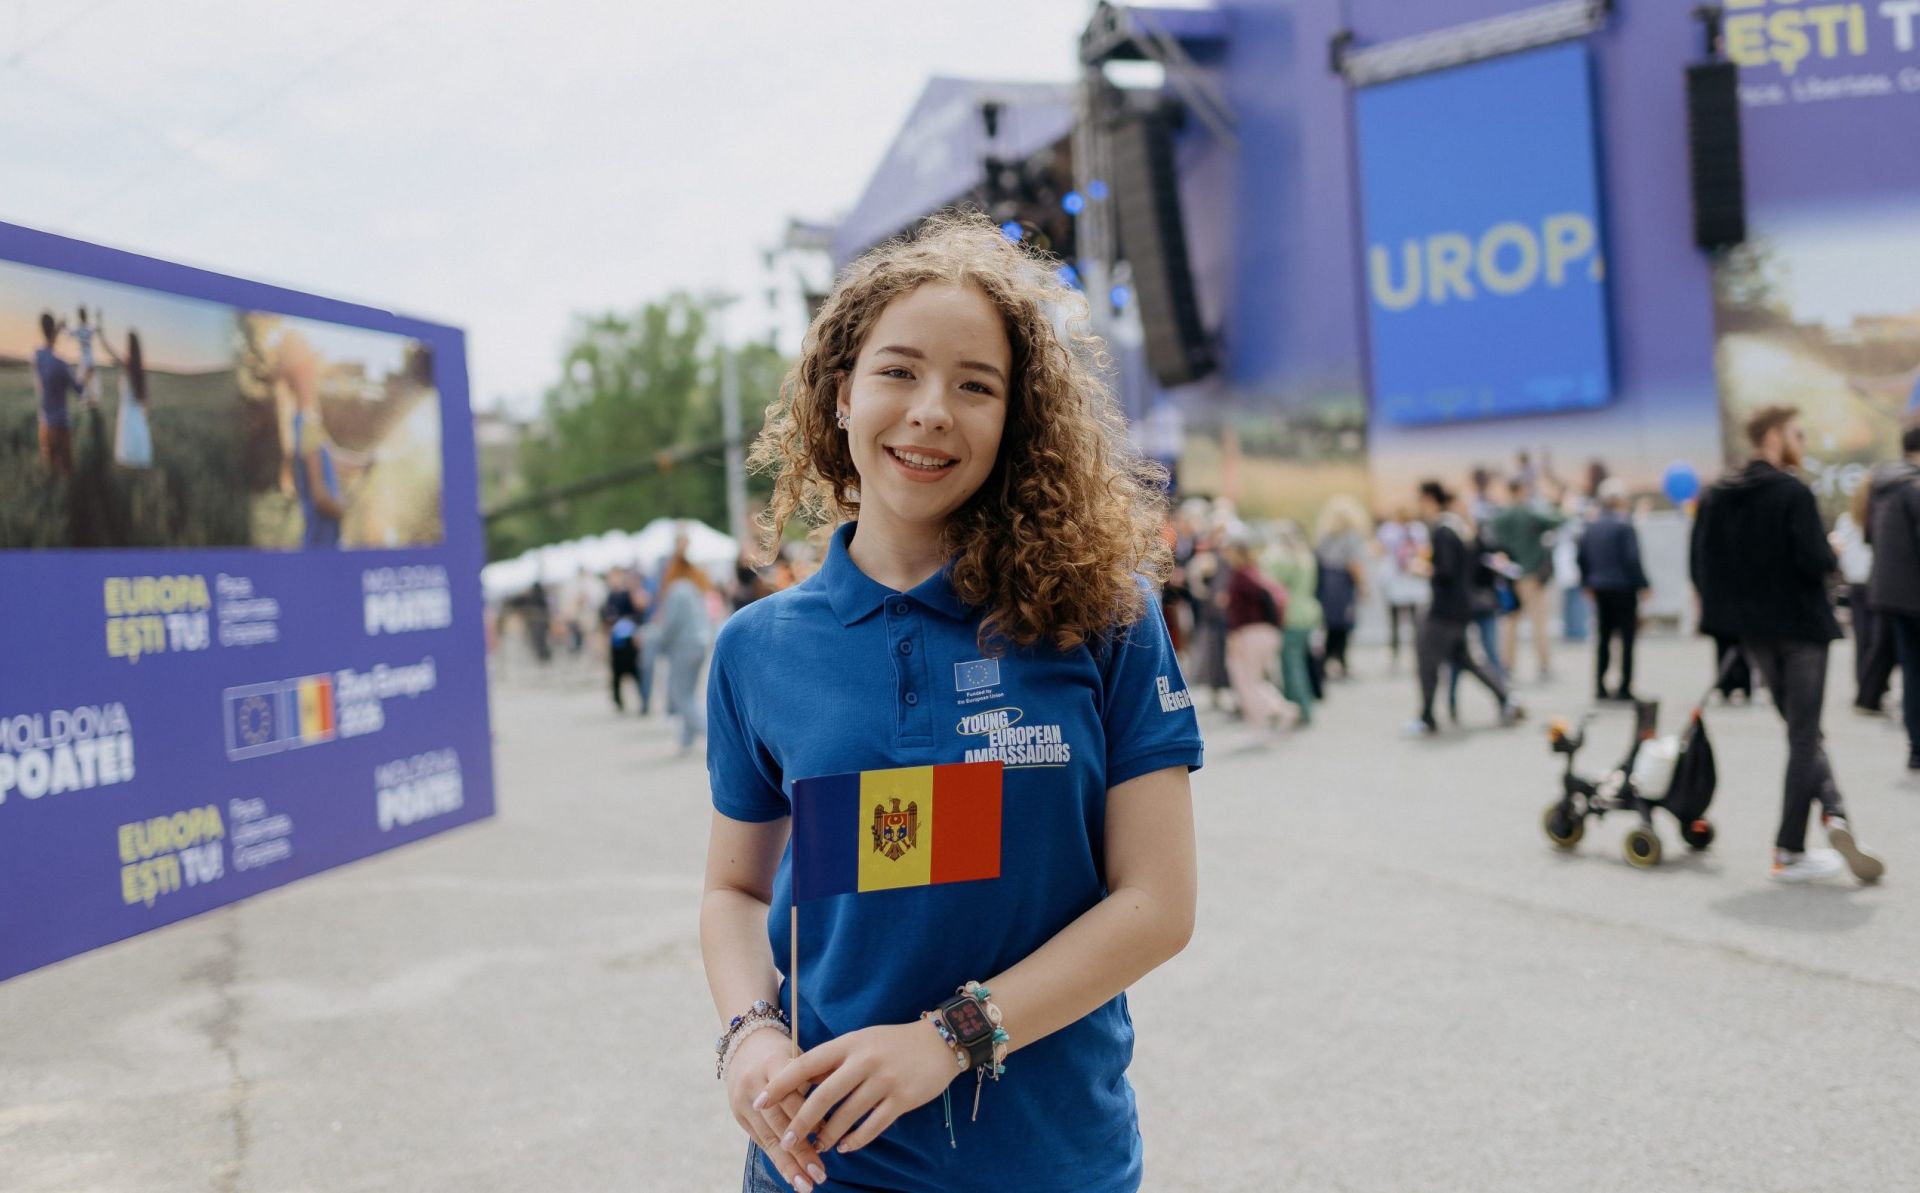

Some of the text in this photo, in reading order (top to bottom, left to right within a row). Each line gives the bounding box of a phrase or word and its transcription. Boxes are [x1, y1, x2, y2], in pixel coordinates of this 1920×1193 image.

[1725, 3, 1867, 77] EȘTI
[1370, 212, 1605, 311] UROP
[104, 574, 211, 616] EUROPA
[105, 615, 166, 665] EȘTI
[166, 610, 210, 652] TU!
[1156, 675, 1169, 695] EU
[961, 710, 1008, 734] YOUNG
[989, 724, 1062, 747] EUROPEAN
[964, 743, 1071, 765] AMBASSADORS
[118, 803, 225, 865] EUROPA
